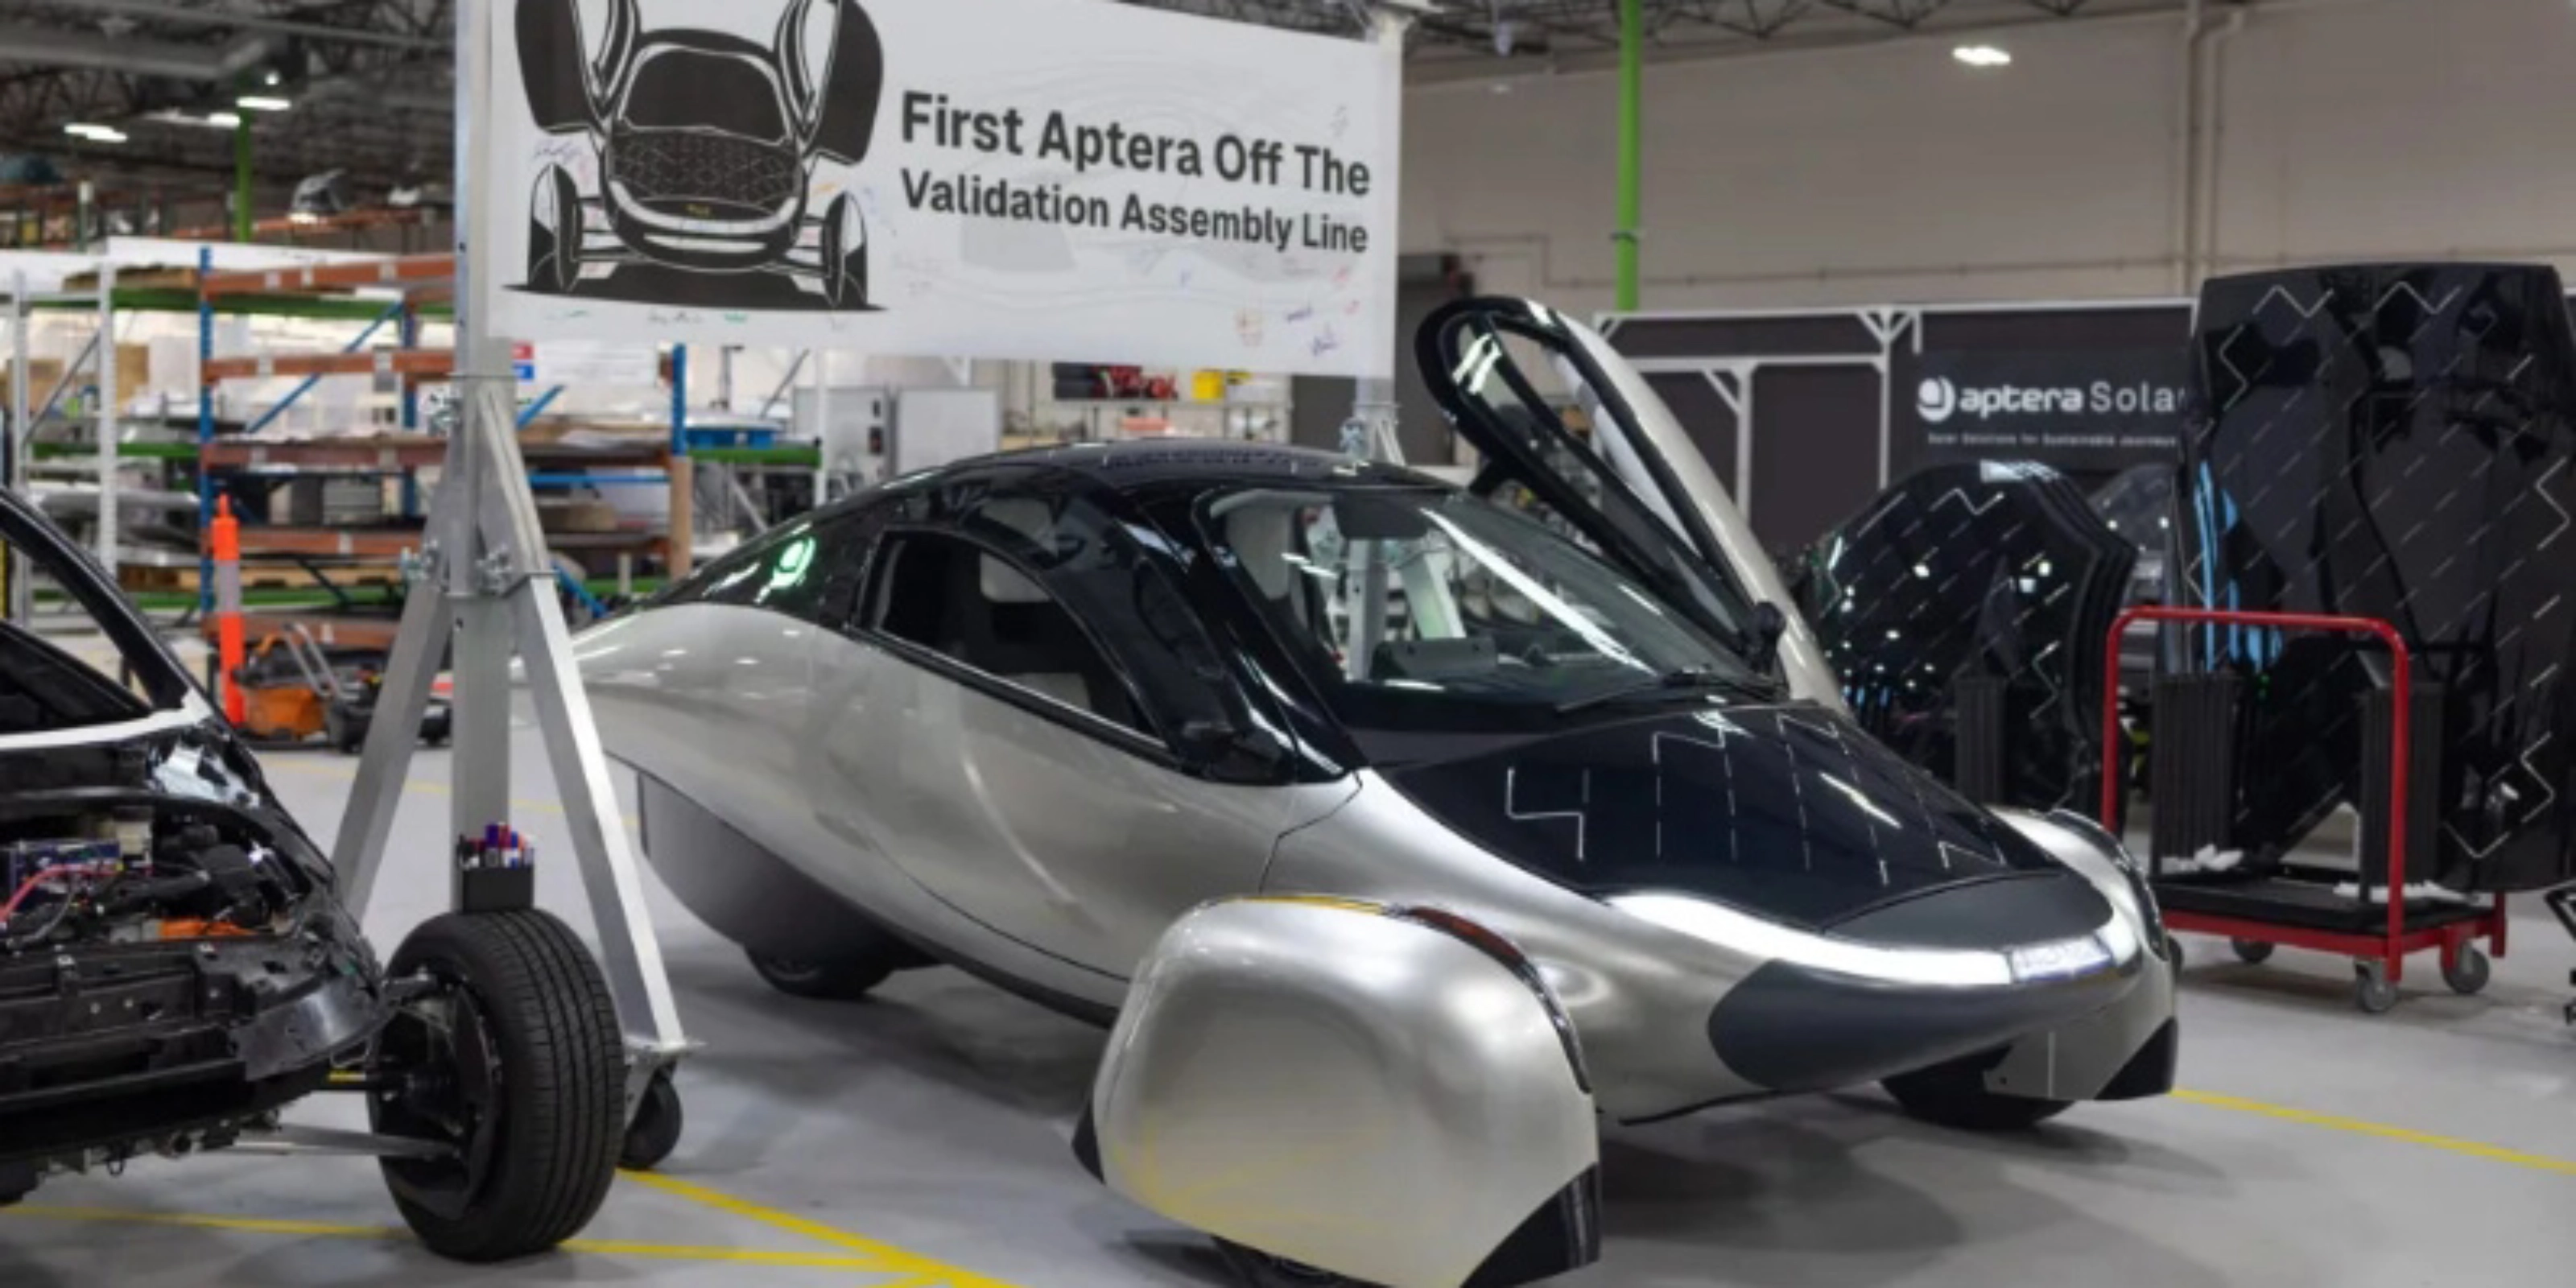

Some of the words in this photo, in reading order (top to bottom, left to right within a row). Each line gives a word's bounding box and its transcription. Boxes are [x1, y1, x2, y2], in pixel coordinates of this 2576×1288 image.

[902, 89, 1023, 156] First
[1038, 111, 1202, 177] Aptera
[1214, 134, 1283, 186] Off
[1294, 145, 1370, 196] The
[901, 168, 1109, 228] Validation
[1121, 193, 1294, 253] Assembly
[1302, 213, 1368, 254] Line
[1958, 384, 2085, 419] aptera
